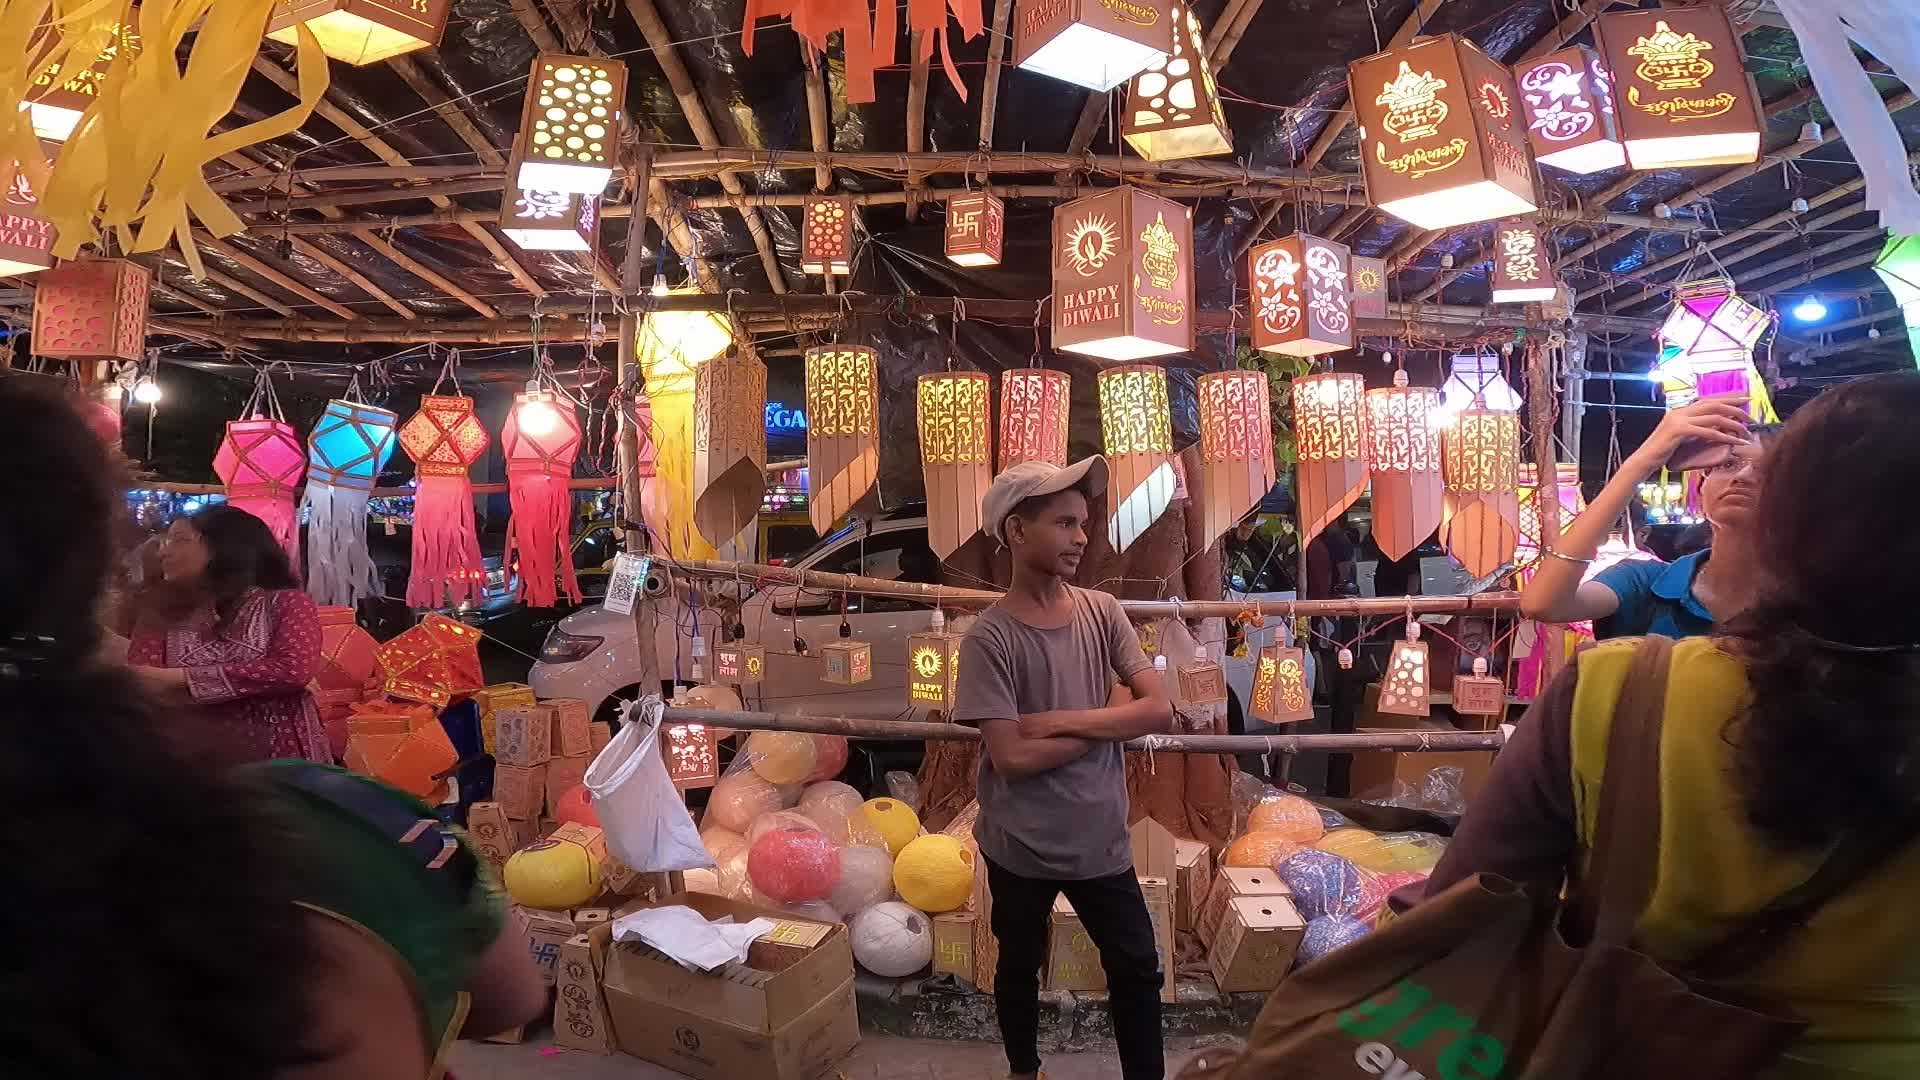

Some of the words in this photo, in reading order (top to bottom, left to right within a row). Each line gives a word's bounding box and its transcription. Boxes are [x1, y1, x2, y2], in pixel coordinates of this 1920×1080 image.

[1063, 284, 1120, 310] HAPPY
[1062, 302, 1121, 329] DIWALI
[912, 682, 944, 693] HAPPY
[912, 690, 943, 701] DIWALI
